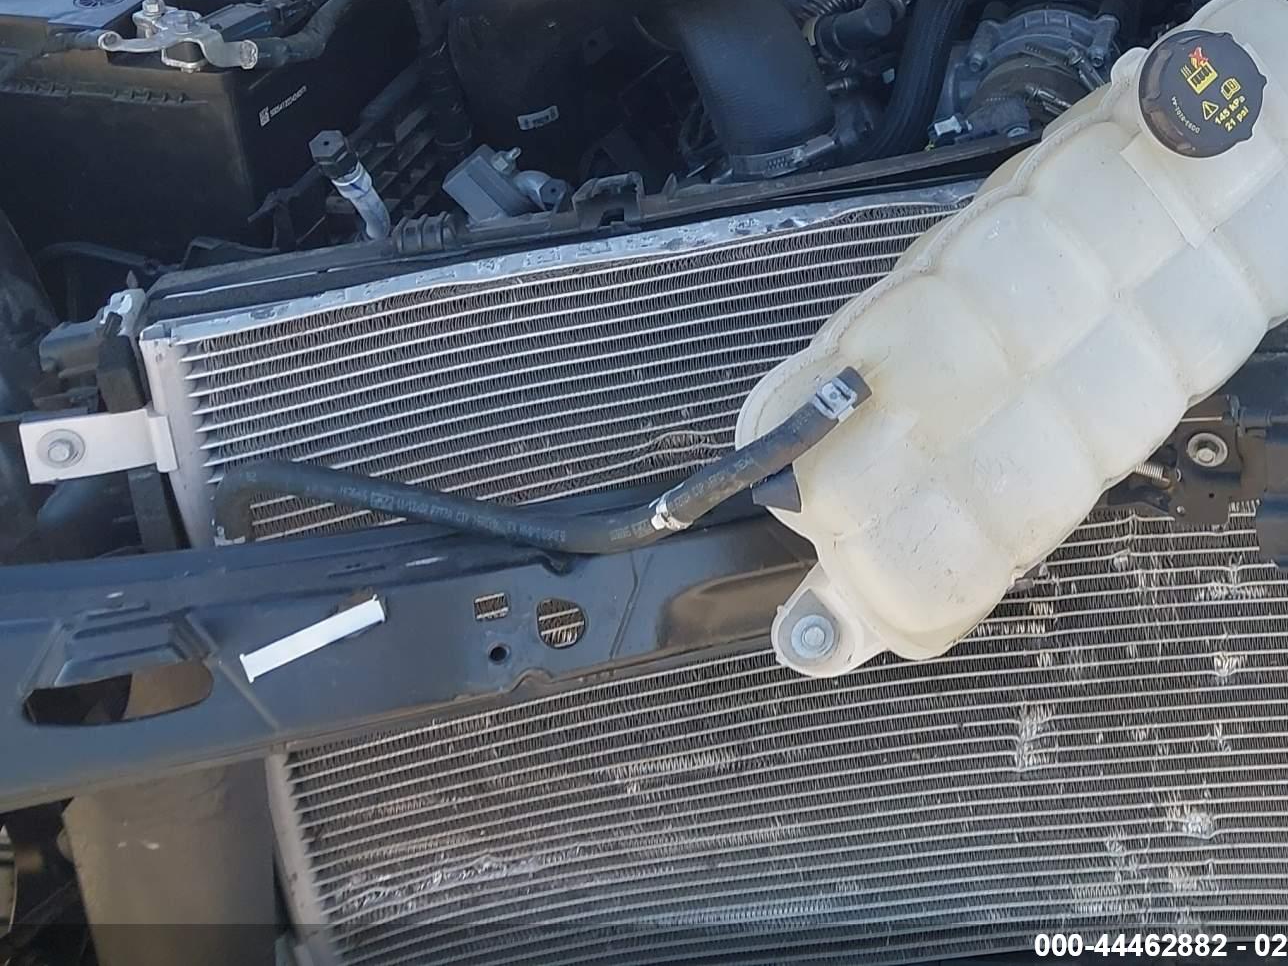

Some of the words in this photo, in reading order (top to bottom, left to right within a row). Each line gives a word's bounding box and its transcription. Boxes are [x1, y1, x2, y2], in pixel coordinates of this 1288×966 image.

[1214, 108, 1231, 125] 145
[1229, 95, 1246, 112] kPa
[1225, 117, 1237, 132] 21
[1236, 106, 1249, 122] psi
